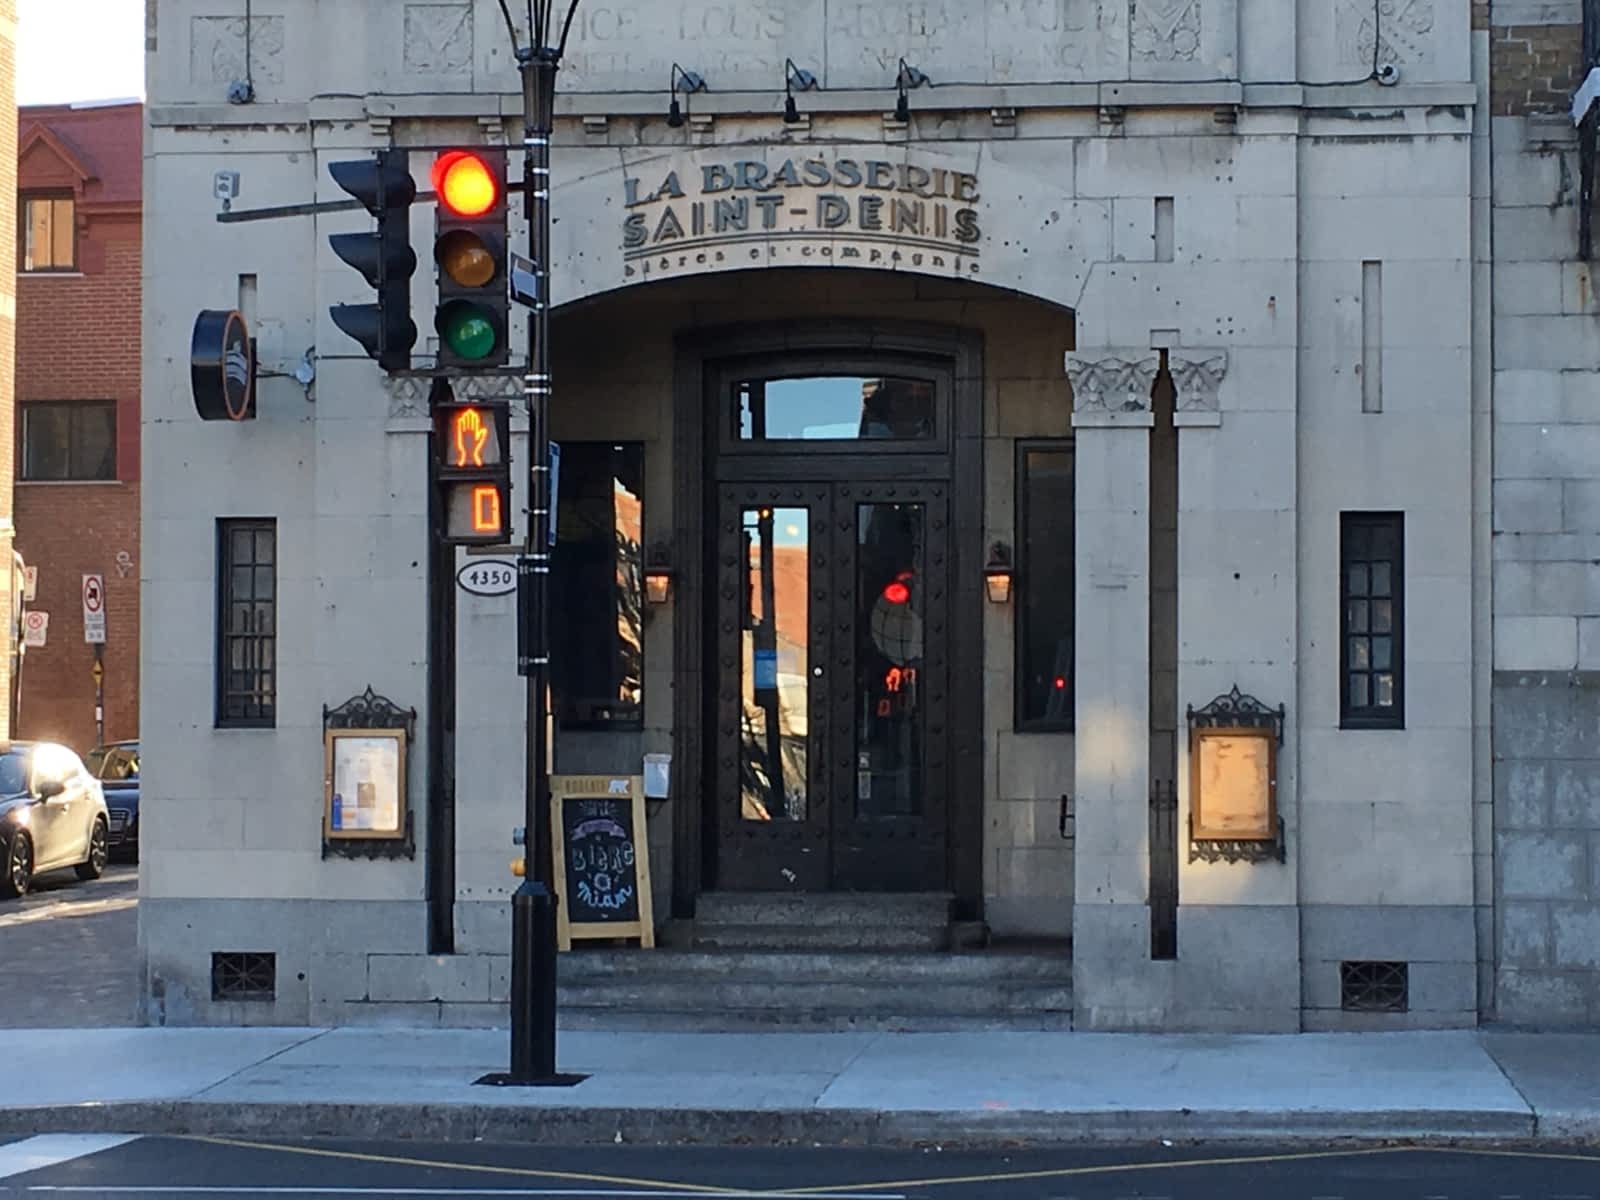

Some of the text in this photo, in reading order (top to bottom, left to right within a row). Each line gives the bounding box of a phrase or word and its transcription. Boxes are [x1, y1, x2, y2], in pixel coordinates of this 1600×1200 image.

[624, 159, 981, 208] LA BRASSERIE
[623, 193, 981, 249] SAINT-DENIS
[750, 248, 777, 259] et
[469, 571, 512, 585] 4350
